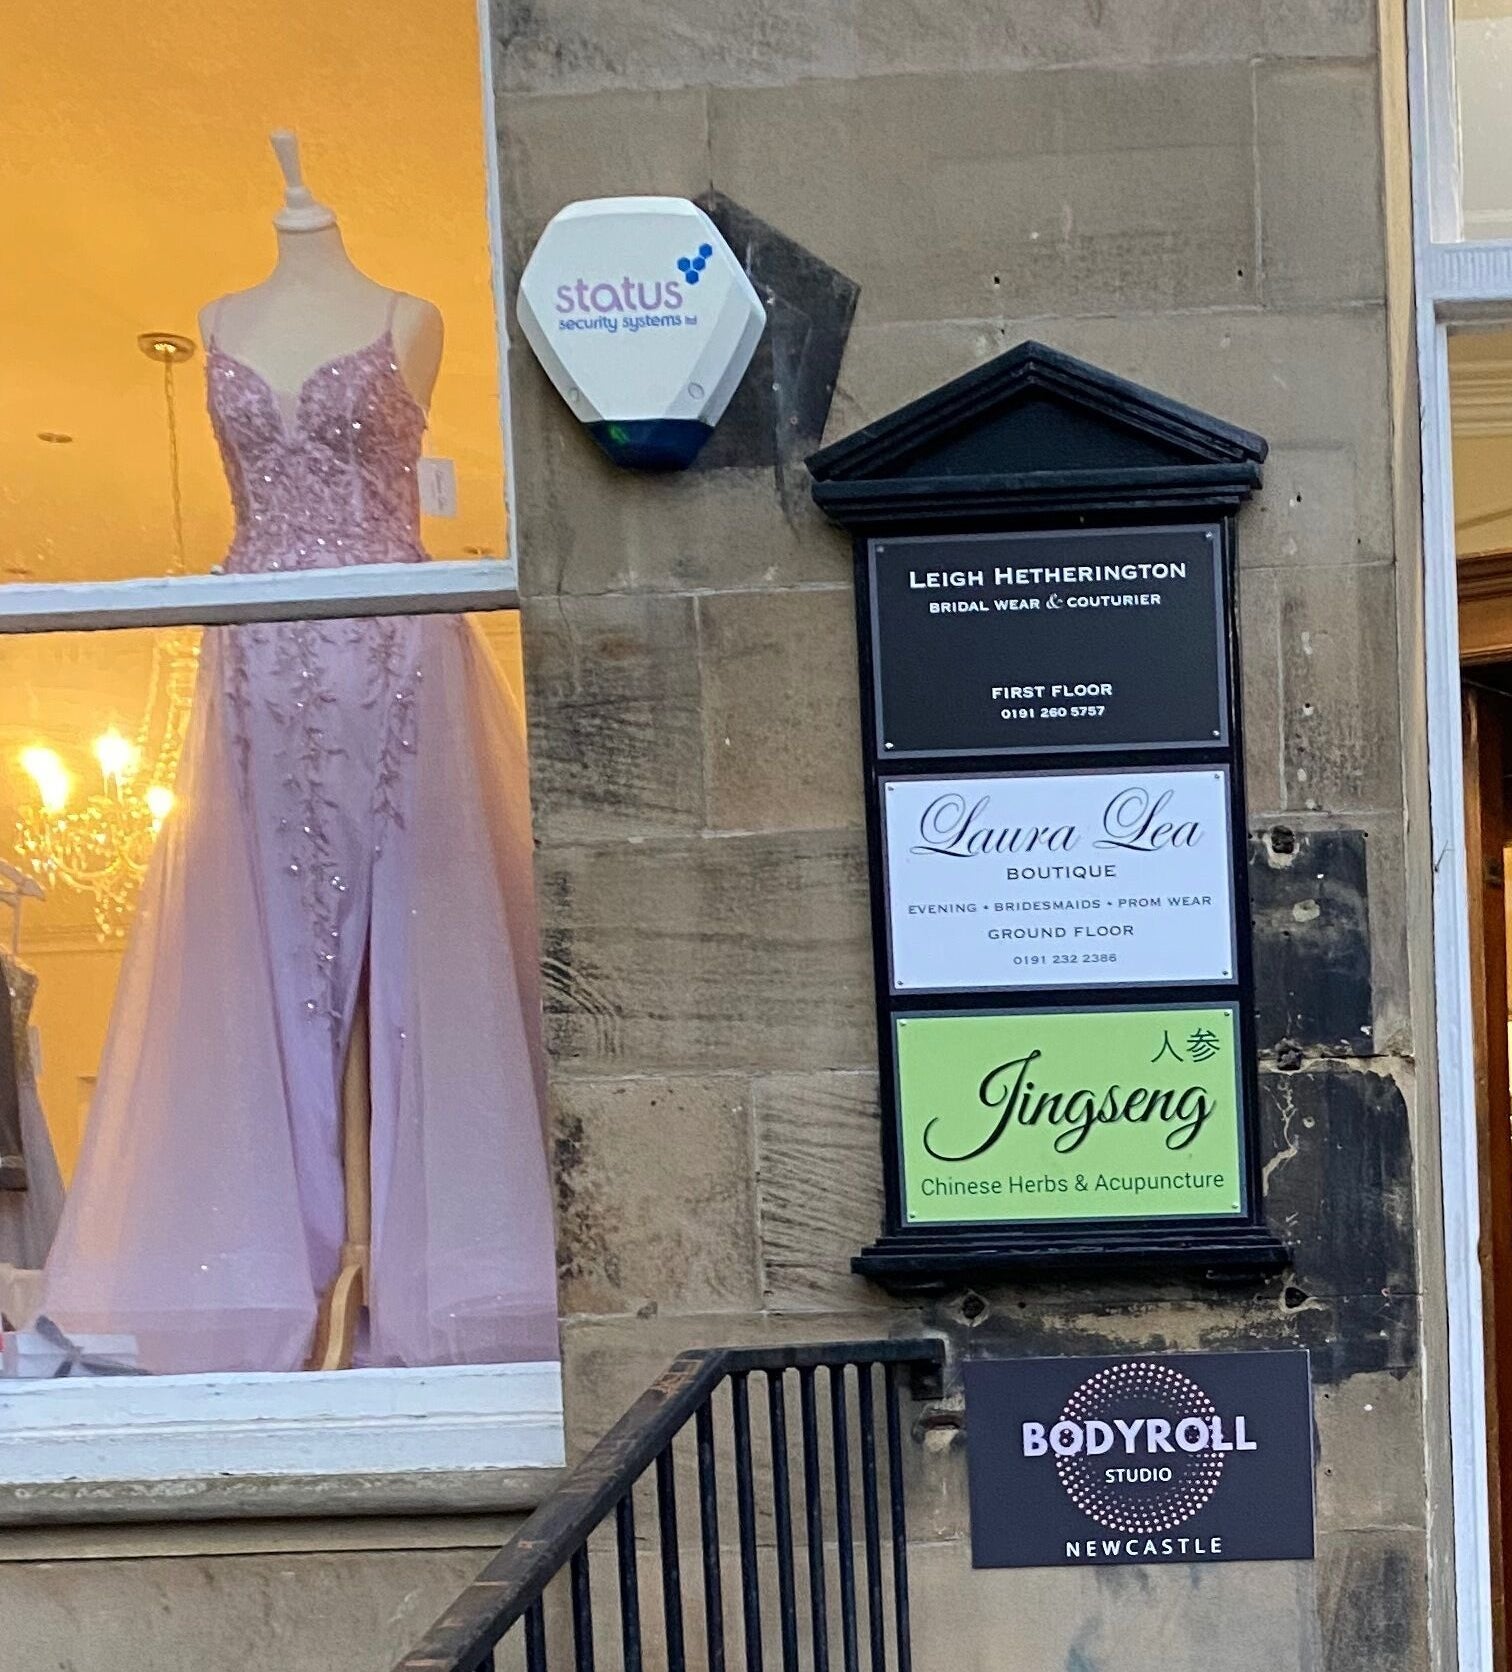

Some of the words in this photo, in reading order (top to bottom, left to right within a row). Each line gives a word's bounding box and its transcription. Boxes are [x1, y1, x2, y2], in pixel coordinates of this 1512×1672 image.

[555, 276, 684, 313] status
[559, 315, 618, 333] security
[622, 314, 682, 332] systems
[909, 569, 984, 589] LEIGH
[994, 562, 1187, 586] HETHERINGTON
[929, 600, 990, 614] BRIDAL
[994, 598, 1041, 611] WEAR
[1046, 593, 1064, 609] &
[1066, 593, 1161, 608] COUTURIER
[992, 685, 1046, 699] FIRST
[1051, 683, 1113, 698] FLOOR
[1001, 708, 1035, 719] 0191
[1040, 706, 1068, 718] 260
[1070, 705, 1105, 717] 5757
[910, 792, 1082, 858] Laura
[1092, 786, 1206, 852] Lea
[1006, 864, 1118, 881] BOUTIQUE
[908, 903, 977, 915] EVENING
[994, 899, 1101, 913] BRIDESMAIDS
[1118, 897, 1161, 908] PROM
[1168, 896, 1212, 907] WEAR
[988, 926, 1067, 940] GROUND
[1074, 924, 1134, 937] FLOOR
[1013, 955, 1046, 965] 0191
[1052, 954, 1078, 964] 232
[1150, 1028, 1221, 1063] 人参
[923, 1049, 1217, 1162] Jingseng
[921, 1177, 1001, 1197] Chinese
[1009, 1174, 1068, 1194] Herbs
[1075, 1174, 1089, 1192] &
[1095, 1172, 1224, 1195] Acupuncture
[1022, 1415, 1257, 1457] BODYROLL
[1105, 1467, 1173, 1484] STUDIO
[1066, 1537, 1223, 1557] NEWCASTLE
